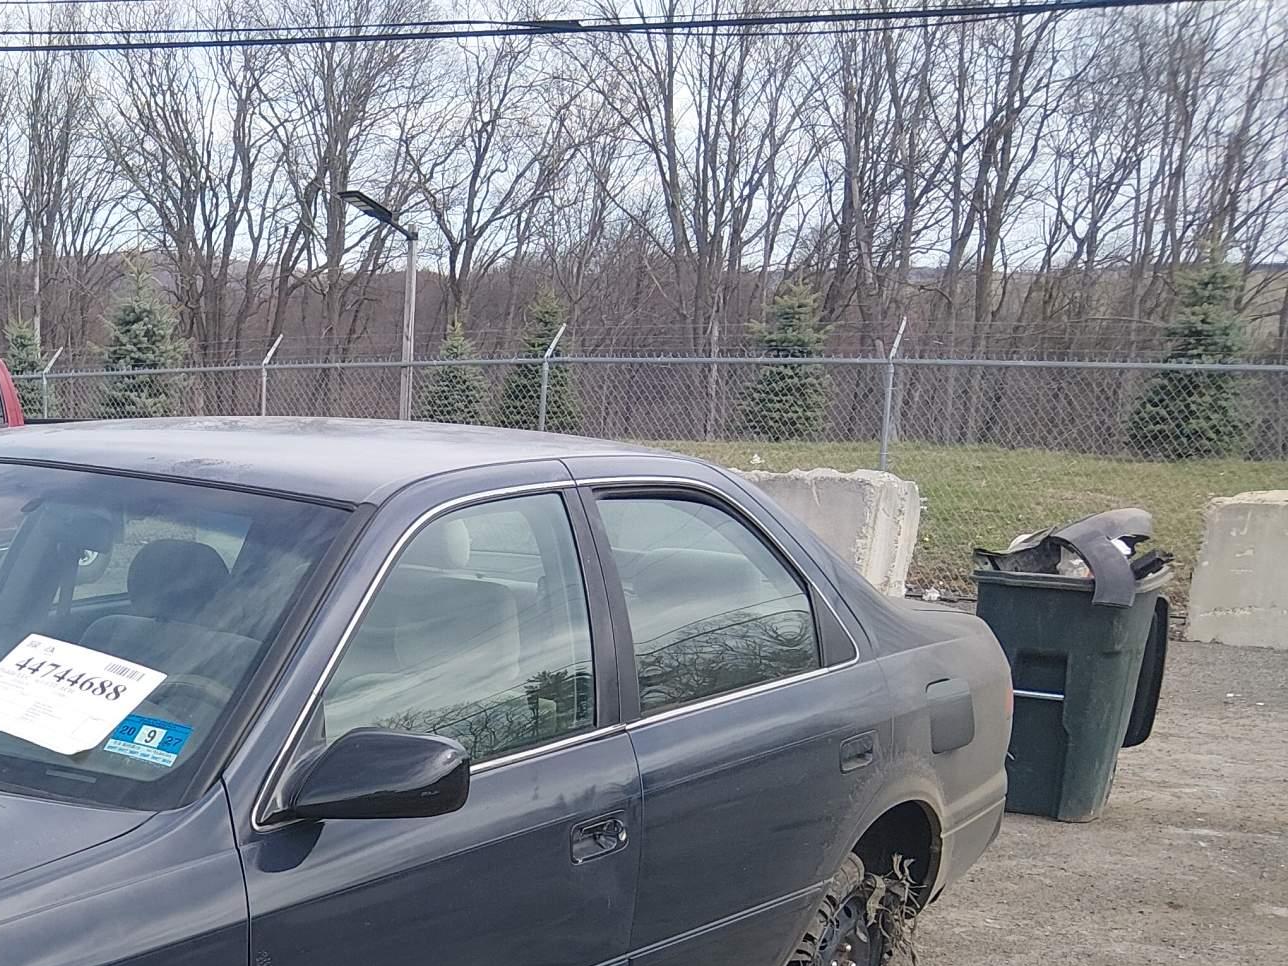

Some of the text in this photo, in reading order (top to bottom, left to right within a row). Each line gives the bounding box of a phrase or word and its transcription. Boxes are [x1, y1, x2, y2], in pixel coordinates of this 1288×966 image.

[14, 657, 128, 701] 44744688
[120, 725, 136, 736] 20
[144, 729, 157, 743] 9
